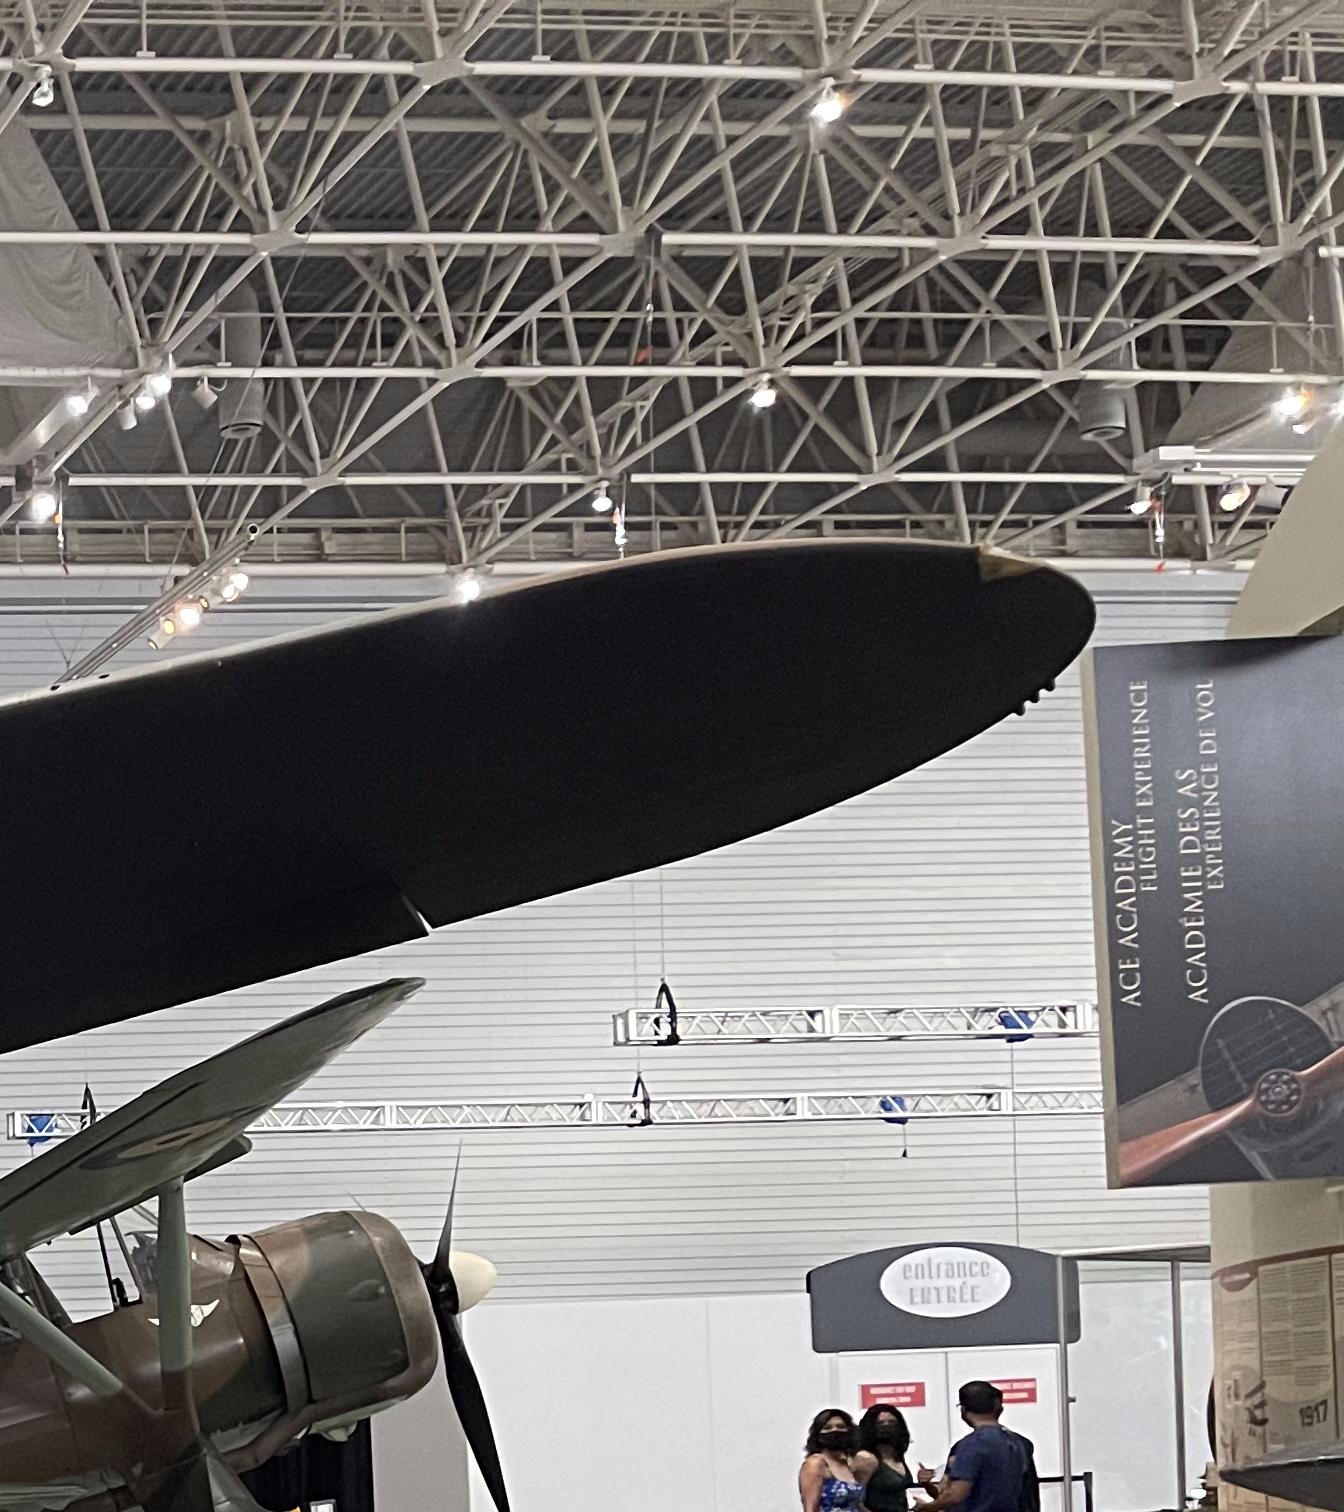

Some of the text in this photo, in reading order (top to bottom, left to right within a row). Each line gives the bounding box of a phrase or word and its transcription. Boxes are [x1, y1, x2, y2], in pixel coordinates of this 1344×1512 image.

[1128, 680, 1159, 891] FLIGHT EXPERIENCE
[1194, 679, 1224, 890] EXPÉRIENCE DE VOL
[1111, 819, 1142, 1007] ACE ACADEMY
[1174, 768, 1209, 1004] ACADÉMIE DES AS
[902, 1258, 991, 1280] entrance
[909, 1281, 982, 1305] ENTRÉE
[1299, 1398, 1328, 1427] 1917
